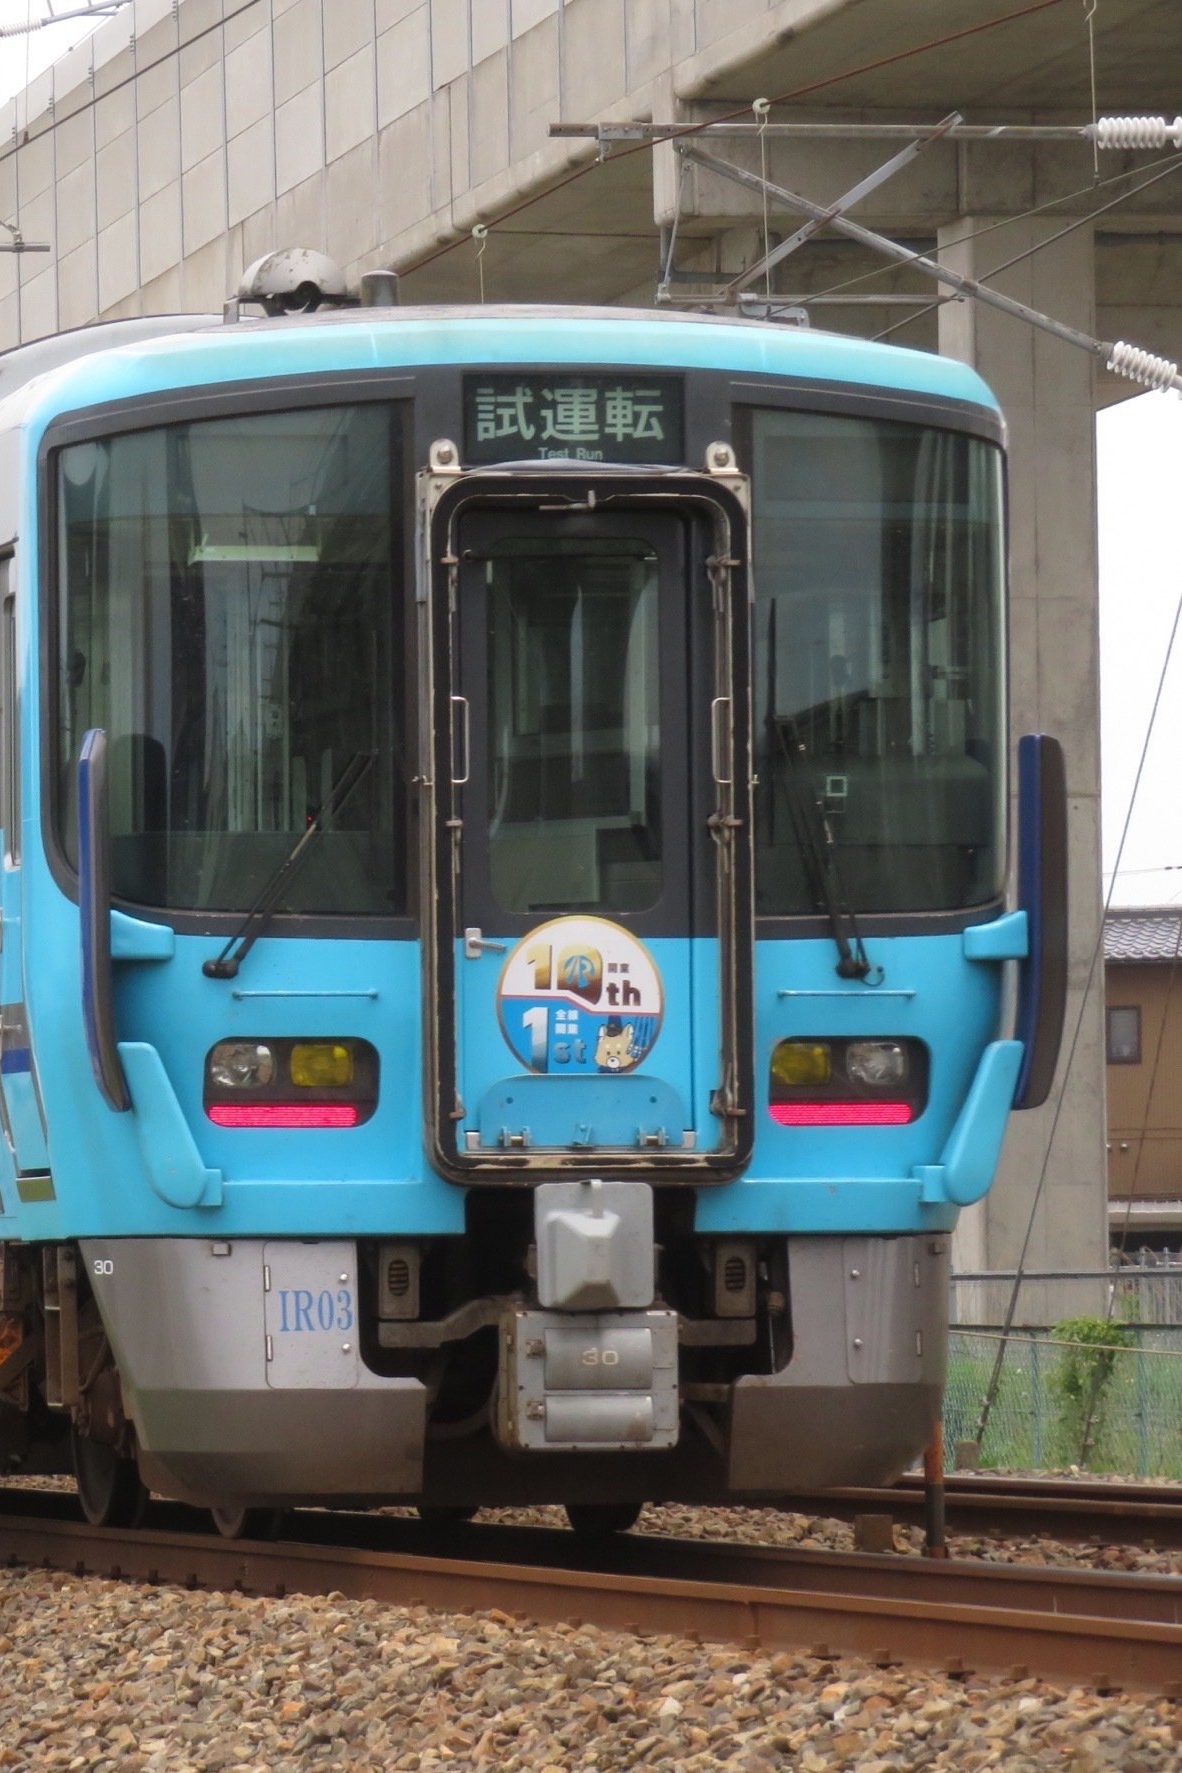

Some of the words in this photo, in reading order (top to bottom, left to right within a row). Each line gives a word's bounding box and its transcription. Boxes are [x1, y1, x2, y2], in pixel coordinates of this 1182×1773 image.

[476, 387, 665, 441] 試運転
[538, 448, 569, 460] Test
[577, 448, 603, 461] Run
[94, 1260, 114, 1274] 30
[278, 1290, 354, 1332] IR03
[582, 1349, 619, 1366] 30
